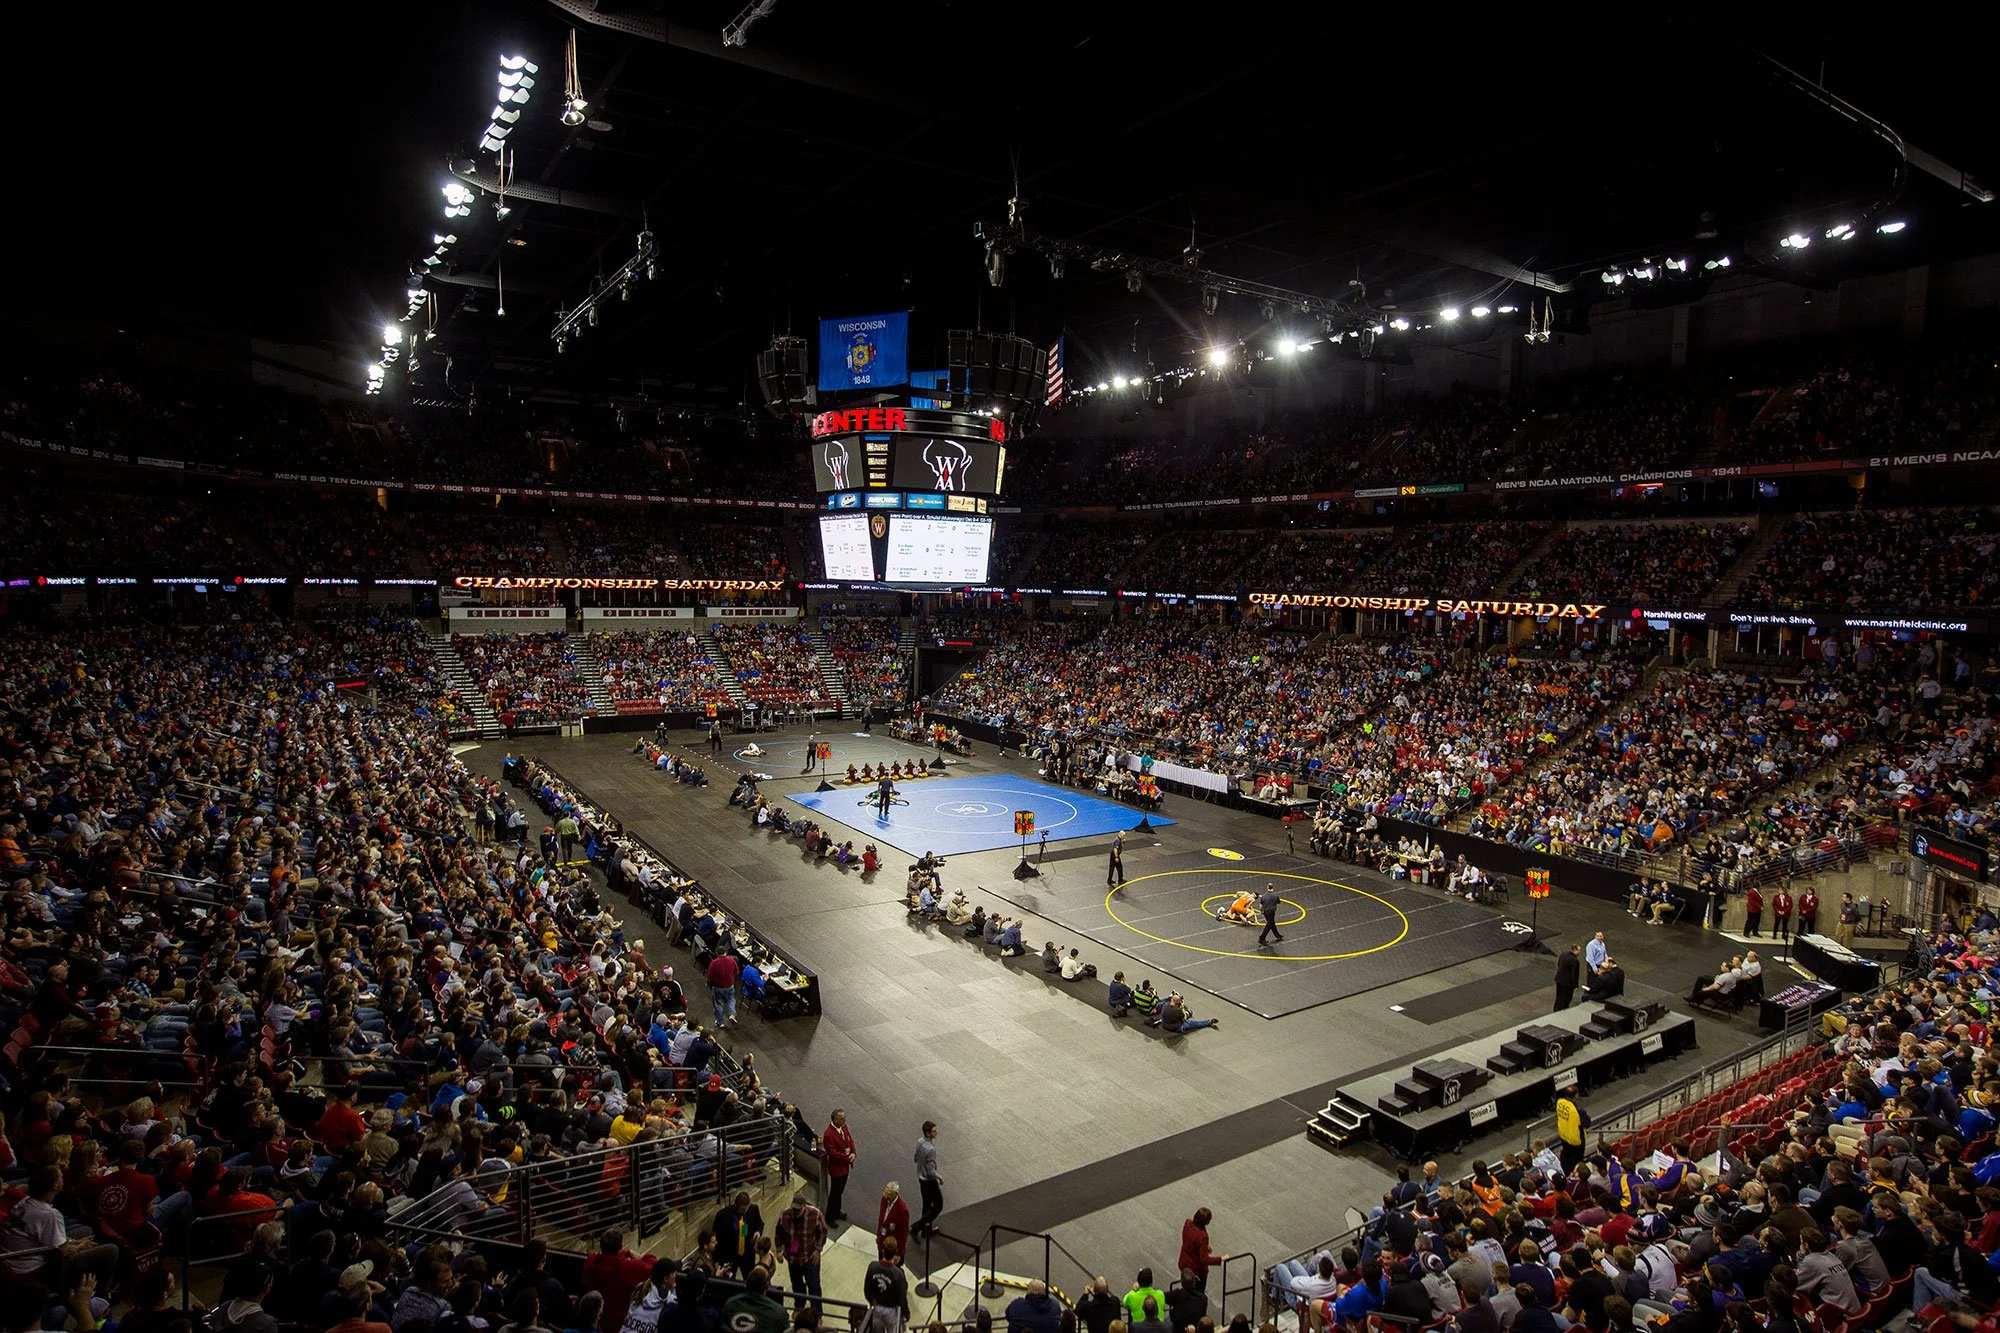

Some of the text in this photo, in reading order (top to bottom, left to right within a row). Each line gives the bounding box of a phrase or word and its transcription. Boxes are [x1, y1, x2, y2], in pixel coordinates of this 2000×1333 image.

[838, 320, 886, 333] WISCONSIN
[854, 375, 870, 386] 1848
[817, 408, 908, 435] CENTER
[20, 437, 42, 449] FOUR
[48, 442, 66, 451] 1941
[70, 446, 89, 455] 2000
[92, 450, 111, 459] 2014
[1869, 457, 1888, 467] 21
[1893, 454, 1947, 466] MEN'S
[274, 472, 308, 482] MEN'S
[311, 475, 327, 484] BIG
[330, 476, 348, 485] TEN
[350, 478, 404, 489] CHAMPIONS
[415, 483, 435, 491] 1907
[1495, 467, 1742, 490] MEN'S NCAA NATIONAL CHAMPIONS 1941
[1205, 498, 1240, 506] CHAMPIONS
[455, 577, 786, 591] CHAMPIONSHIP SATURDAY
[1248, 593, 1606, 619] CHAMPIONSHIP SATURDAY
[1643, 610, 1706, 621] Marshfield Clinic
[1730, 613, 1816, 625] Don't just live. Shine.
[1844, 618, 1967, 632] www.marshfieldclinic.org
[1641, 1038, 1656, 1049] Division
[1554, 1073, 1570, 1085] Division
[1470, 1107, 1488, 1120] Division
[731, 1312, 758, 1332] G
